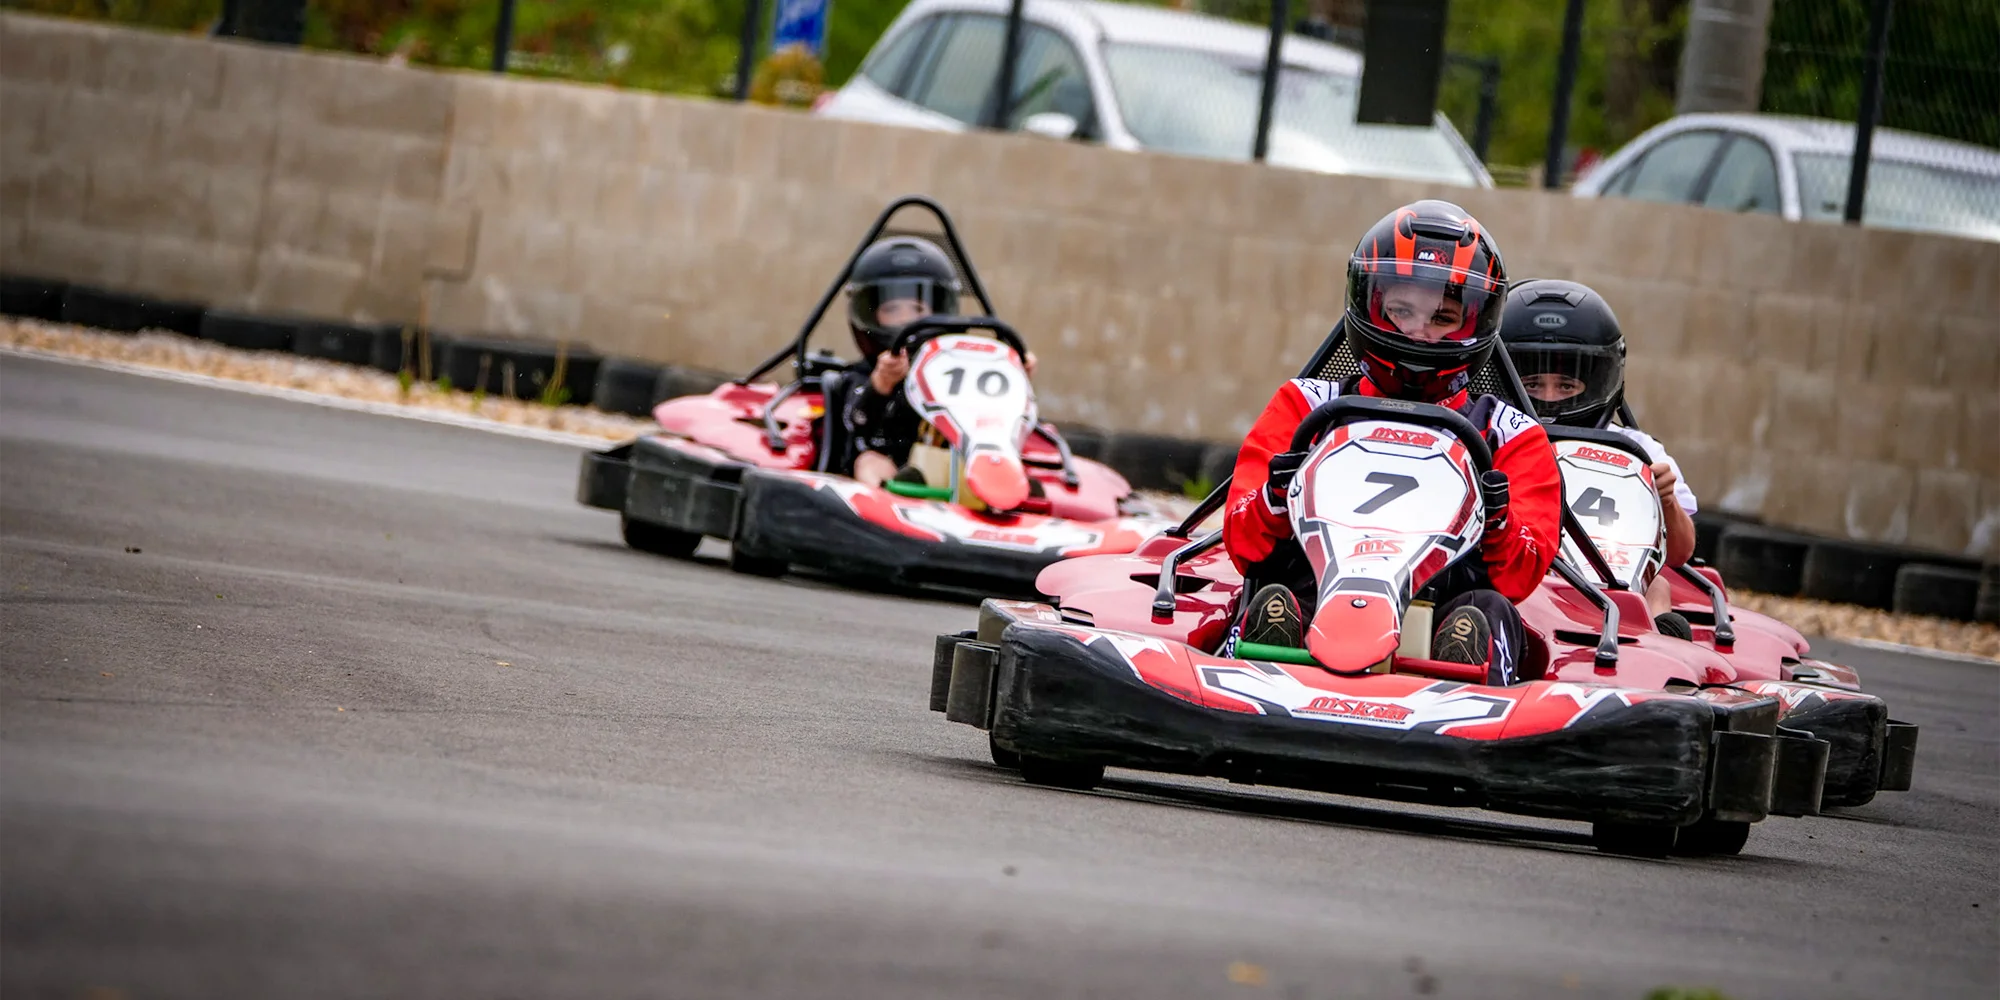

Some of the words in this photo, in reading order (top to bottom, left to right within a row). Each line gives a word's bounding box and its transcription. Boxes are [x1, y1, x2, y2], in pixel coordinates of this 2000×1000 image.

[1539, 317, 1561, 325] BELL
[943, 367, 1009, 397] 10
[1353, 471, 1419, 514] 7
[1571, 487, 1620, 526] 4
